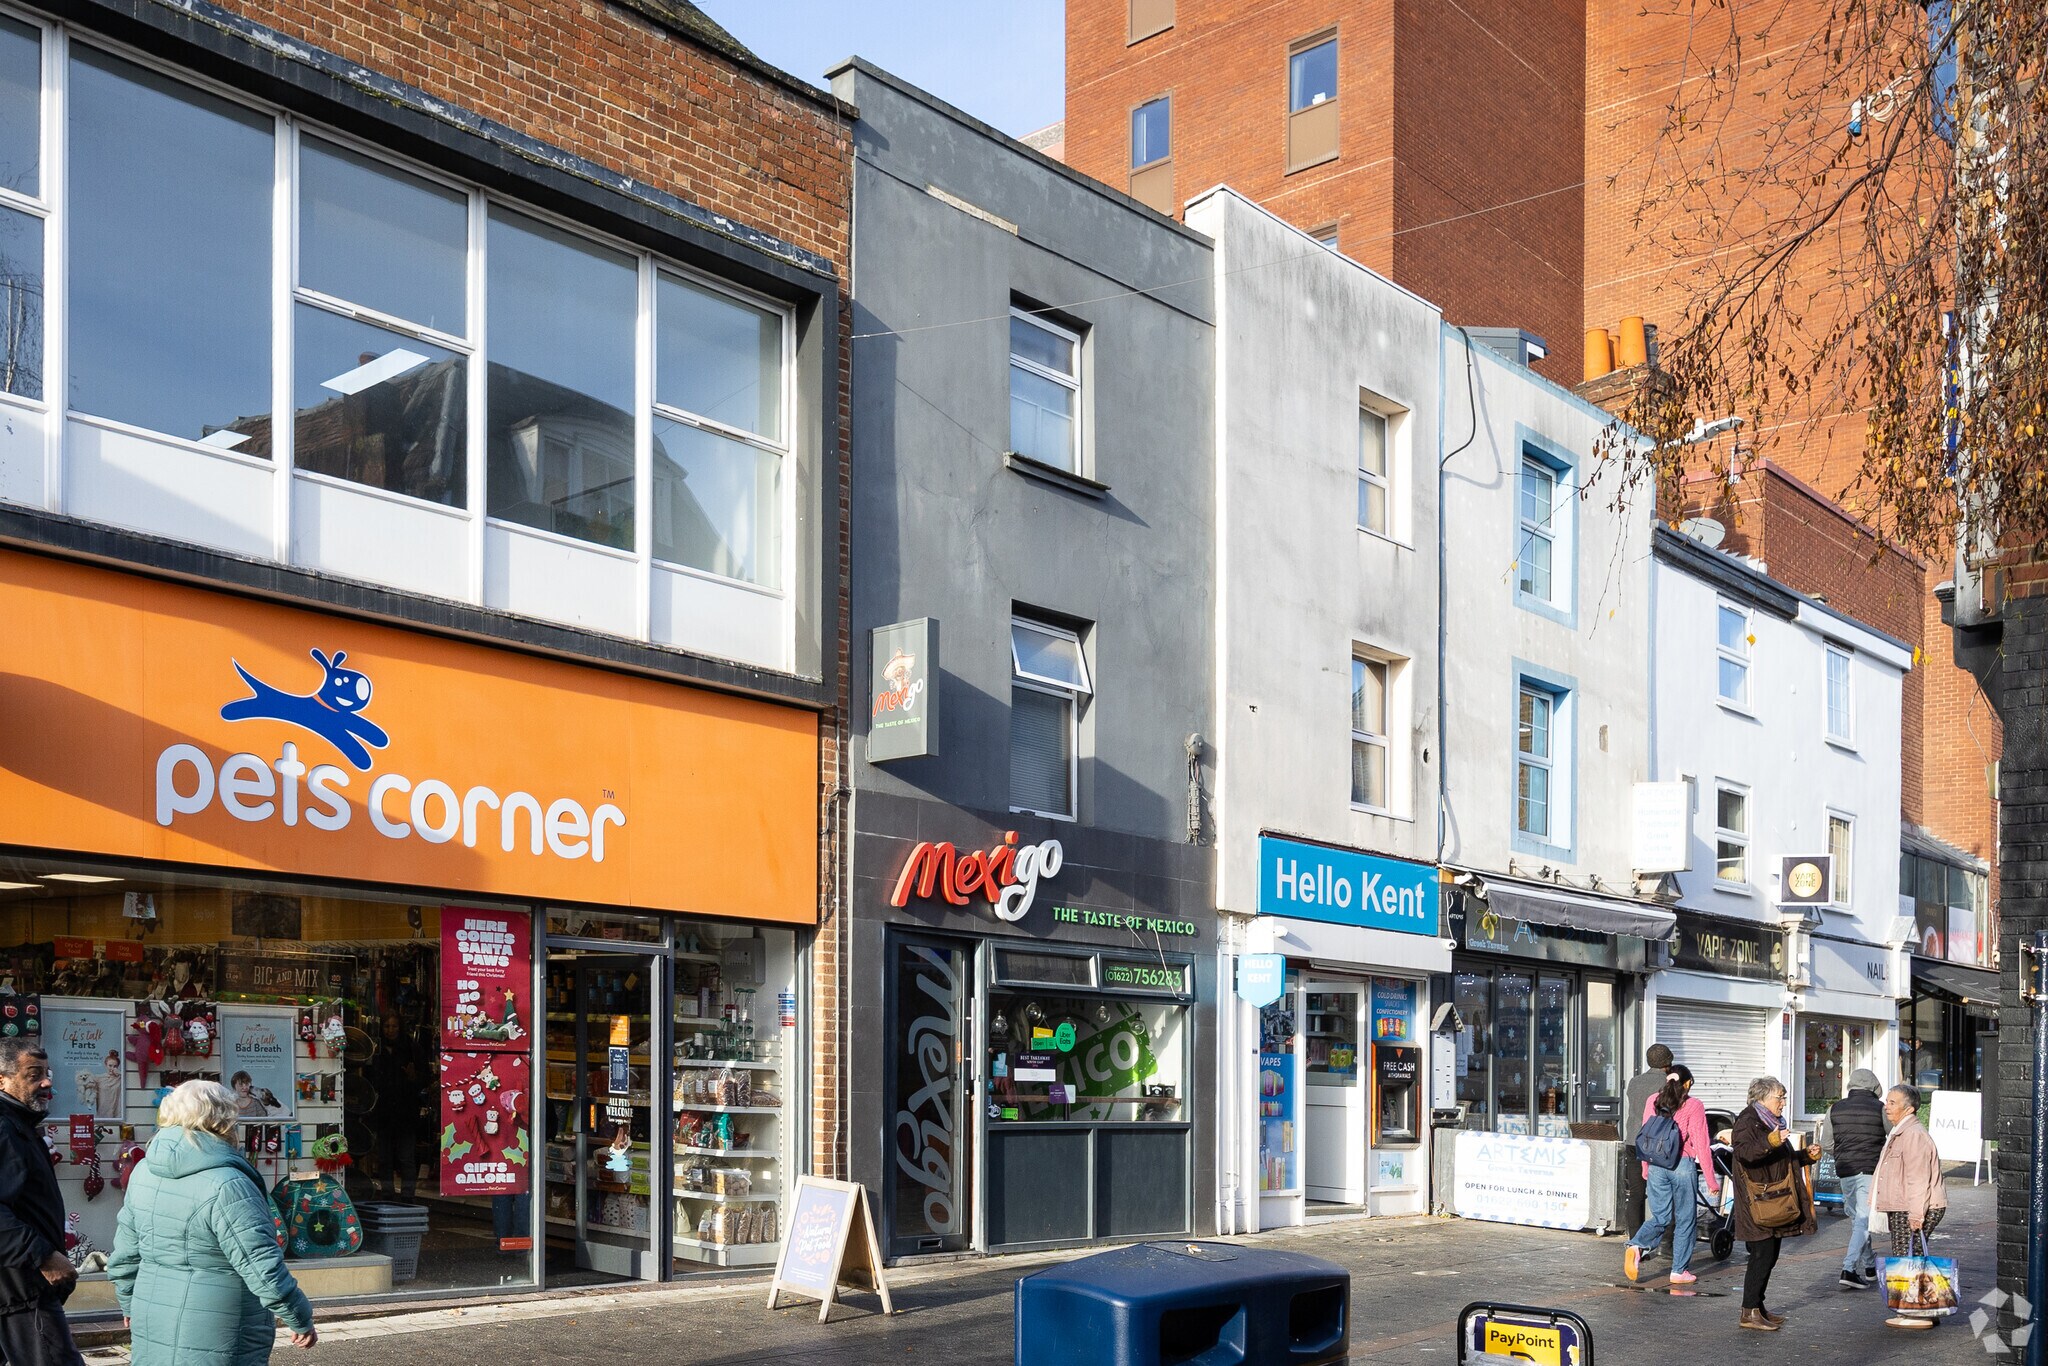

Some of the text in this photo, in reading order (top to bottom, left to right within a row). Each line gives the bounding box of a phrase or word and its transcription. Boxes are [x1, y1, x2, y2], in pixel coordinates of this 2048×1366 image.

[873, 678, 924, 718] Mexigo
[156, 742, 351, 832] pets
[368, 774, 626, 863] corner
[891, 830, 1063, 922] Mexigo
[1795, 872, 1816, 880] VAPE
[1276, 857, 1425, 919] Hello Kent
[1795, 880, 1816, 888] ZONE
[464, 918, 508, 932] HERE
[1053, 907, 1195, 935] THE TASTE OF MEXICO
[456, 929, 516, 944] COMES
[458, 941, 514, 956] SANTA
[1696, 933, 1760, 964] VAPE ZONE
[462, 953, 510, 967] PAWS
[1244, 959, 1273, 969] HELLO
[276, 970, 292, 983] AND
[294, 968, 320, 988] MIX
[1105, 968, 1183, 987] (01622) 756283
[1247, 973, 1272, 983] KENT
[1866, 962, 1886, 981] NAIL
[457, 980, 479, 990] HO
[459, 991, 480, 1004] HO
[1377, 991, 1408, 1000] COLD DRINKS
[456, 1003, 478, 1015] HO
[1376, 1008, 1408, 1016] CONFECTIONERY
[63, 1028, 104, 1041] Let's talk
[240, 1033, 276, 1045] Let's talk
[71, 1040, 96, 1050] Farts
[235, 1043, 282, 1053] Bad Breath
[1260, 1057, 1282, 1067] VAPES
[1383, 1061, 1415, 1072] FREE CASH
[609, 1097, 631, 1108] ALL PETS
[606, 1106, 634, 1118] WELCOME
[1935, 1118, 1970, 1131] NAIL
[463, 1162, 508, 1173] GIFTS
[455, 1173, 516, 1184] GALORE
[1465, 1182, 1487, 1190] OPEN
[1489, 1184, 1505, 1192] FOR
[1507, 1186, 1535, 1195] LUNCH
[1546, 1190, 1578, 1199] DINNER
[1490, 1330, 1555, 1348] PayPoint
